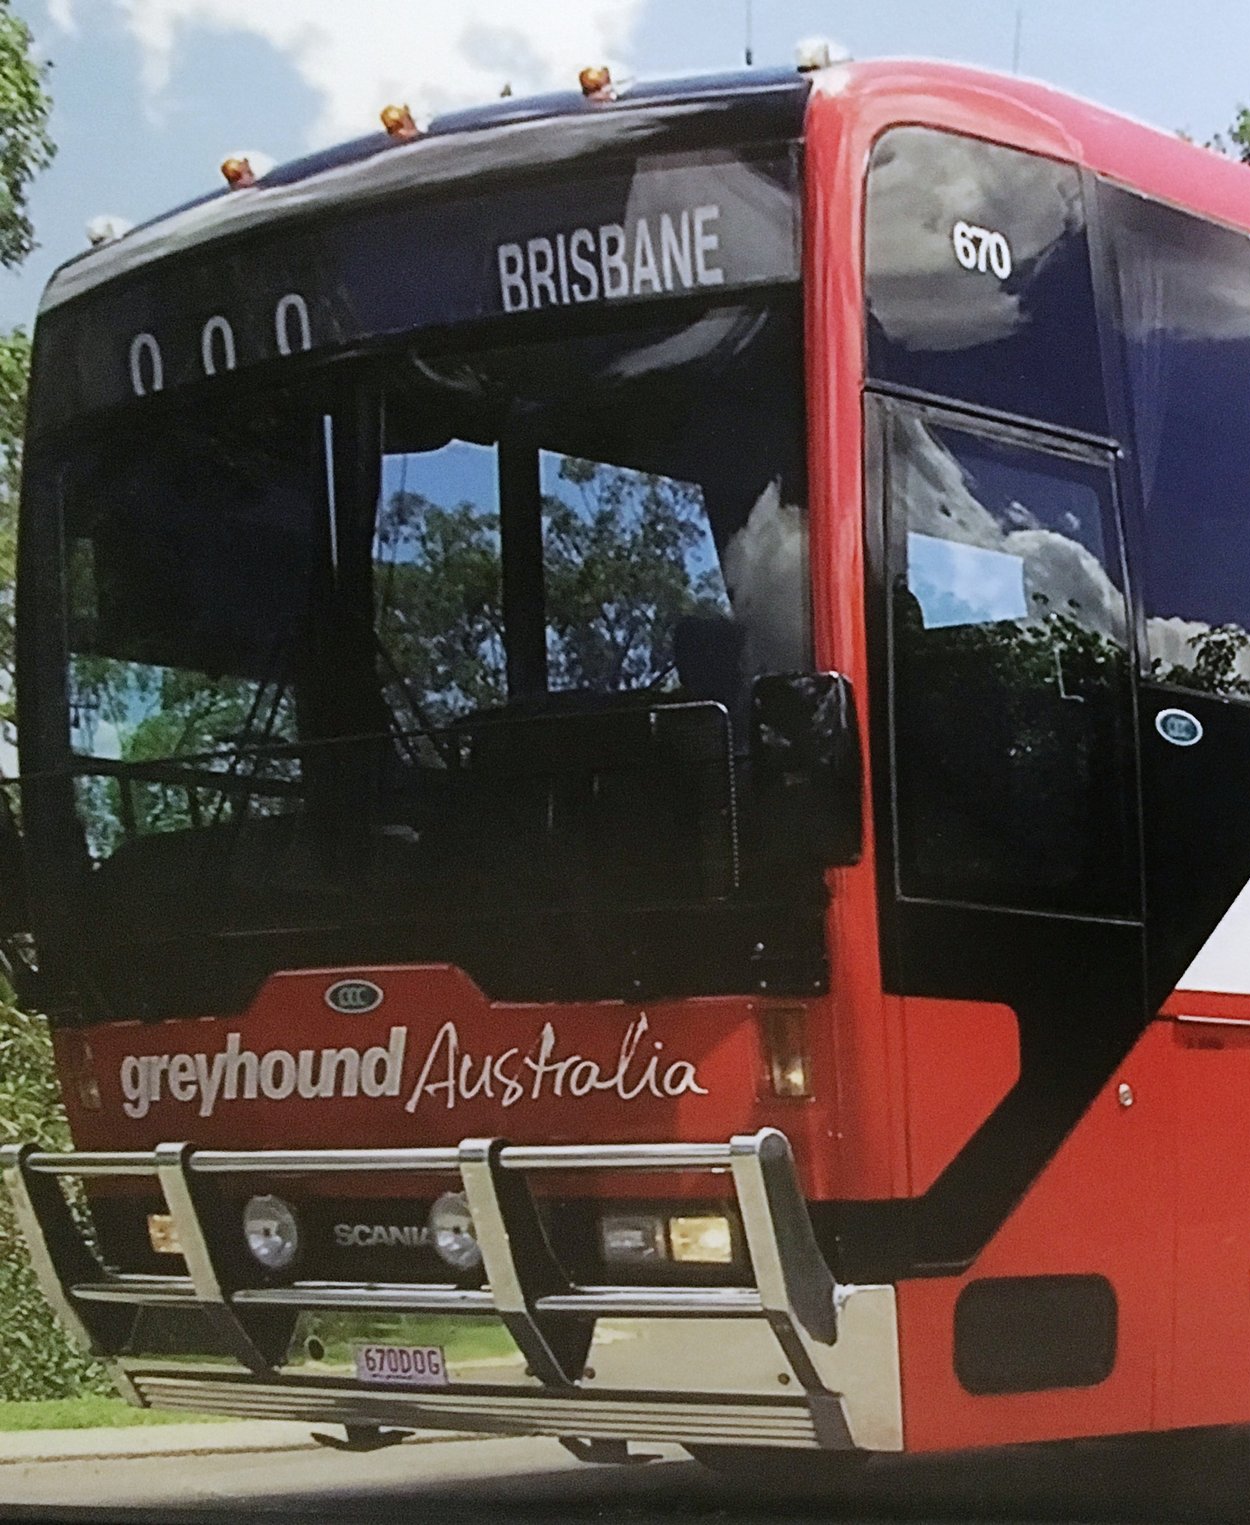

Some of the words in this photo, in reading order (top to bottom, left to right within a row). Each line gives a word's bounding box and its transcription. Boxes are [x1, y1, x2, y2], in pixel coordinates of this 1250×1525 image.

[498, 204, 724, 312] BRISBANE
[953, 220, 1012, 280] 670
[120, 1026, 408, 1118] greyhound
[405, 1011, 708, 1113] Australia
[364, 1348, 440, 1375] 670DOG
